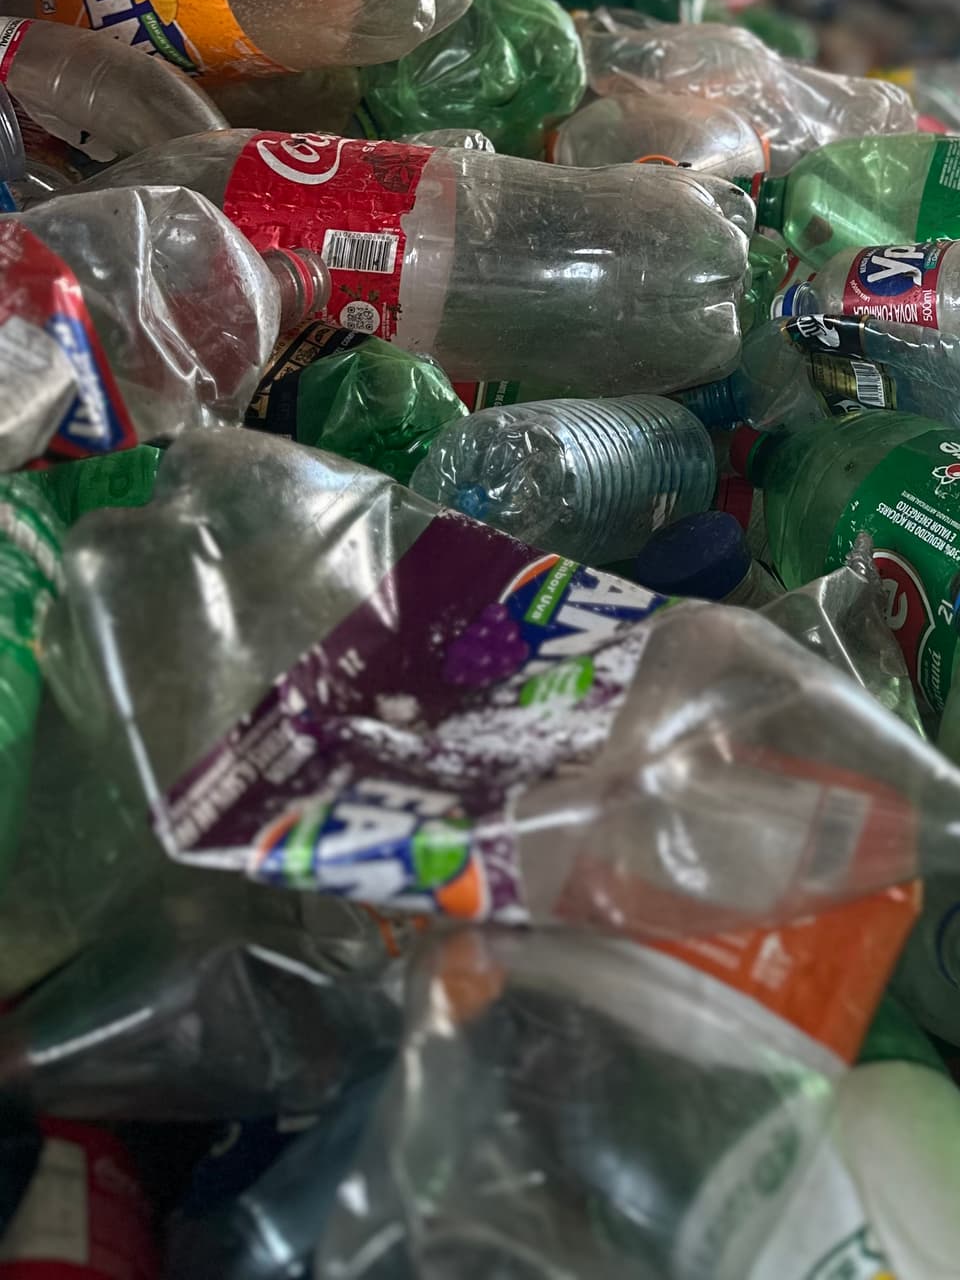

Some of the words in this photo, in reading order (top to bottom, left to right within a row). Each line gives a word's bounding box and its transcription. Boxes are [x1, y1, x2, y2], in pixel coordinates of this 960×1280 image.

[867, 245, 925, 286] Yp
[893, 303, 918, 322] NOVA
[922, 289, 932, 321] 500ml
[895, 501, 933, 528] ENERGÉTICO
[903, 519, 917, 533] EM
[914, 524, 945, 550] REDUZIDO
[928, 519, 951, 540] VALOR
[531, 593, 553, 620] Uva
